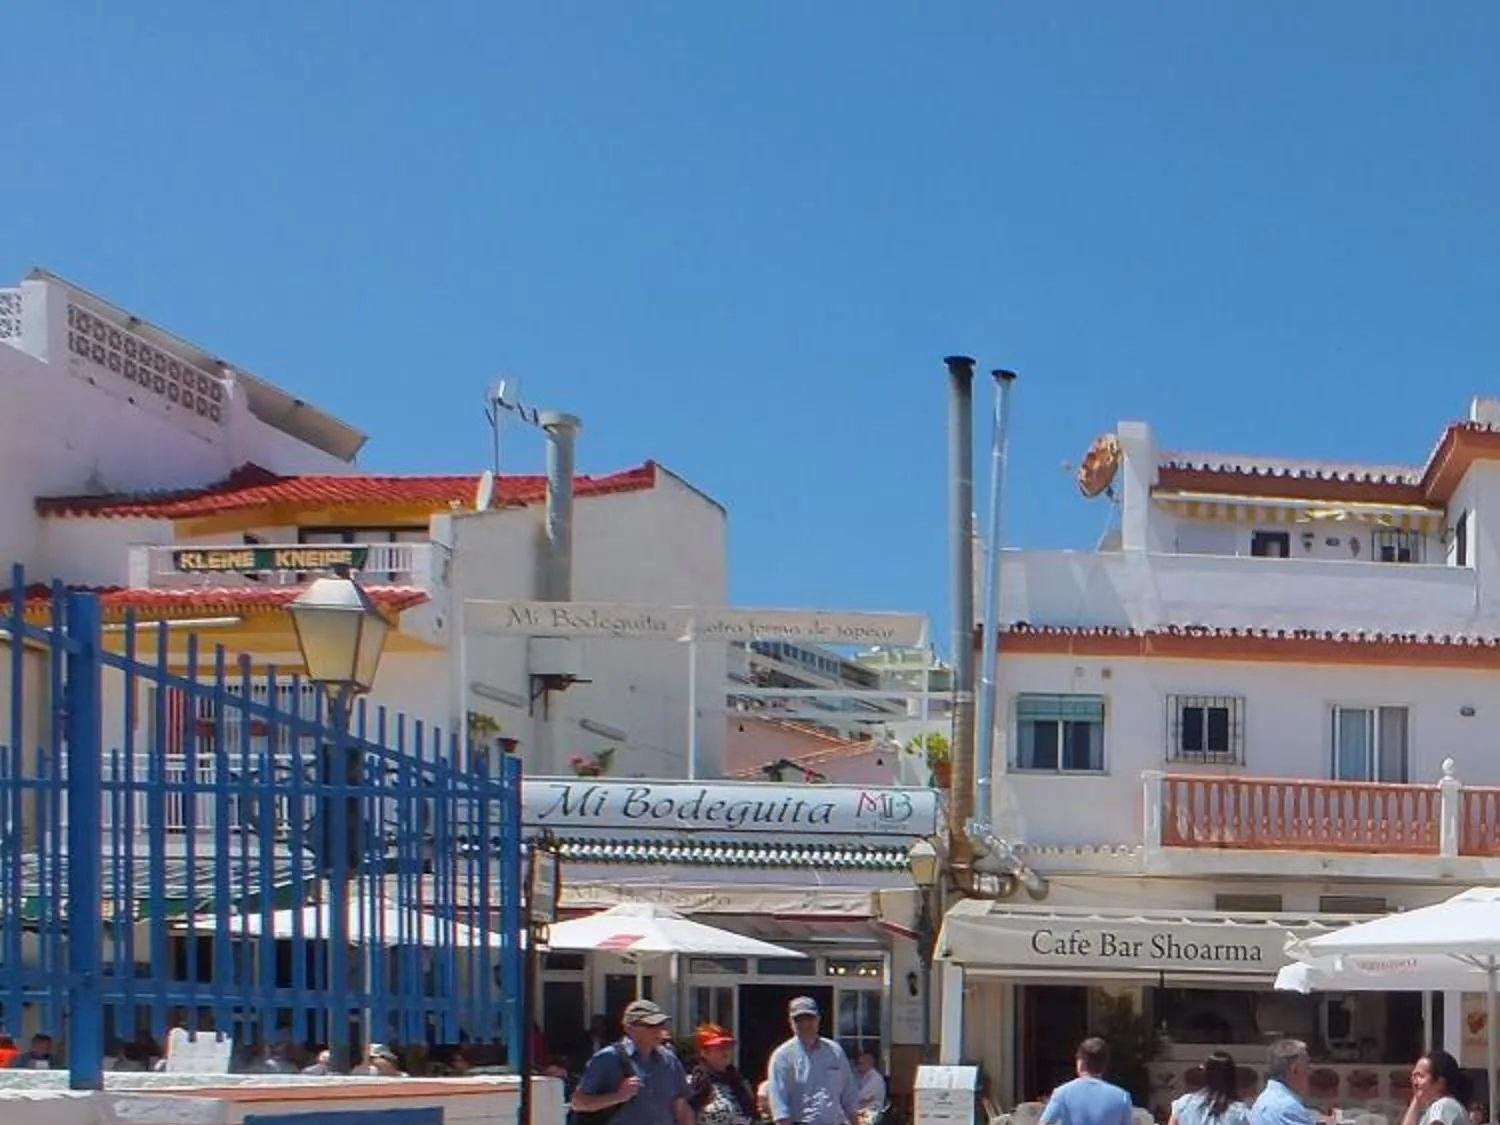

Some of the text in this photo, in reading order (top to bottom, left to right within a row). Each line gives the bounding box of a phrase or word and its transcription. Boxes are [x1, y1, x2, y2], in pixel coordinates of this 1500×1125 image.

[180, 551, 255, 570] KLEINE
[506, 606, 668, 638] Mi Bodeguita
[538, 784, 837, 830] Mi Bodeguita
[1031, 929, 1262, 961] Cafe Bar Shoarma
